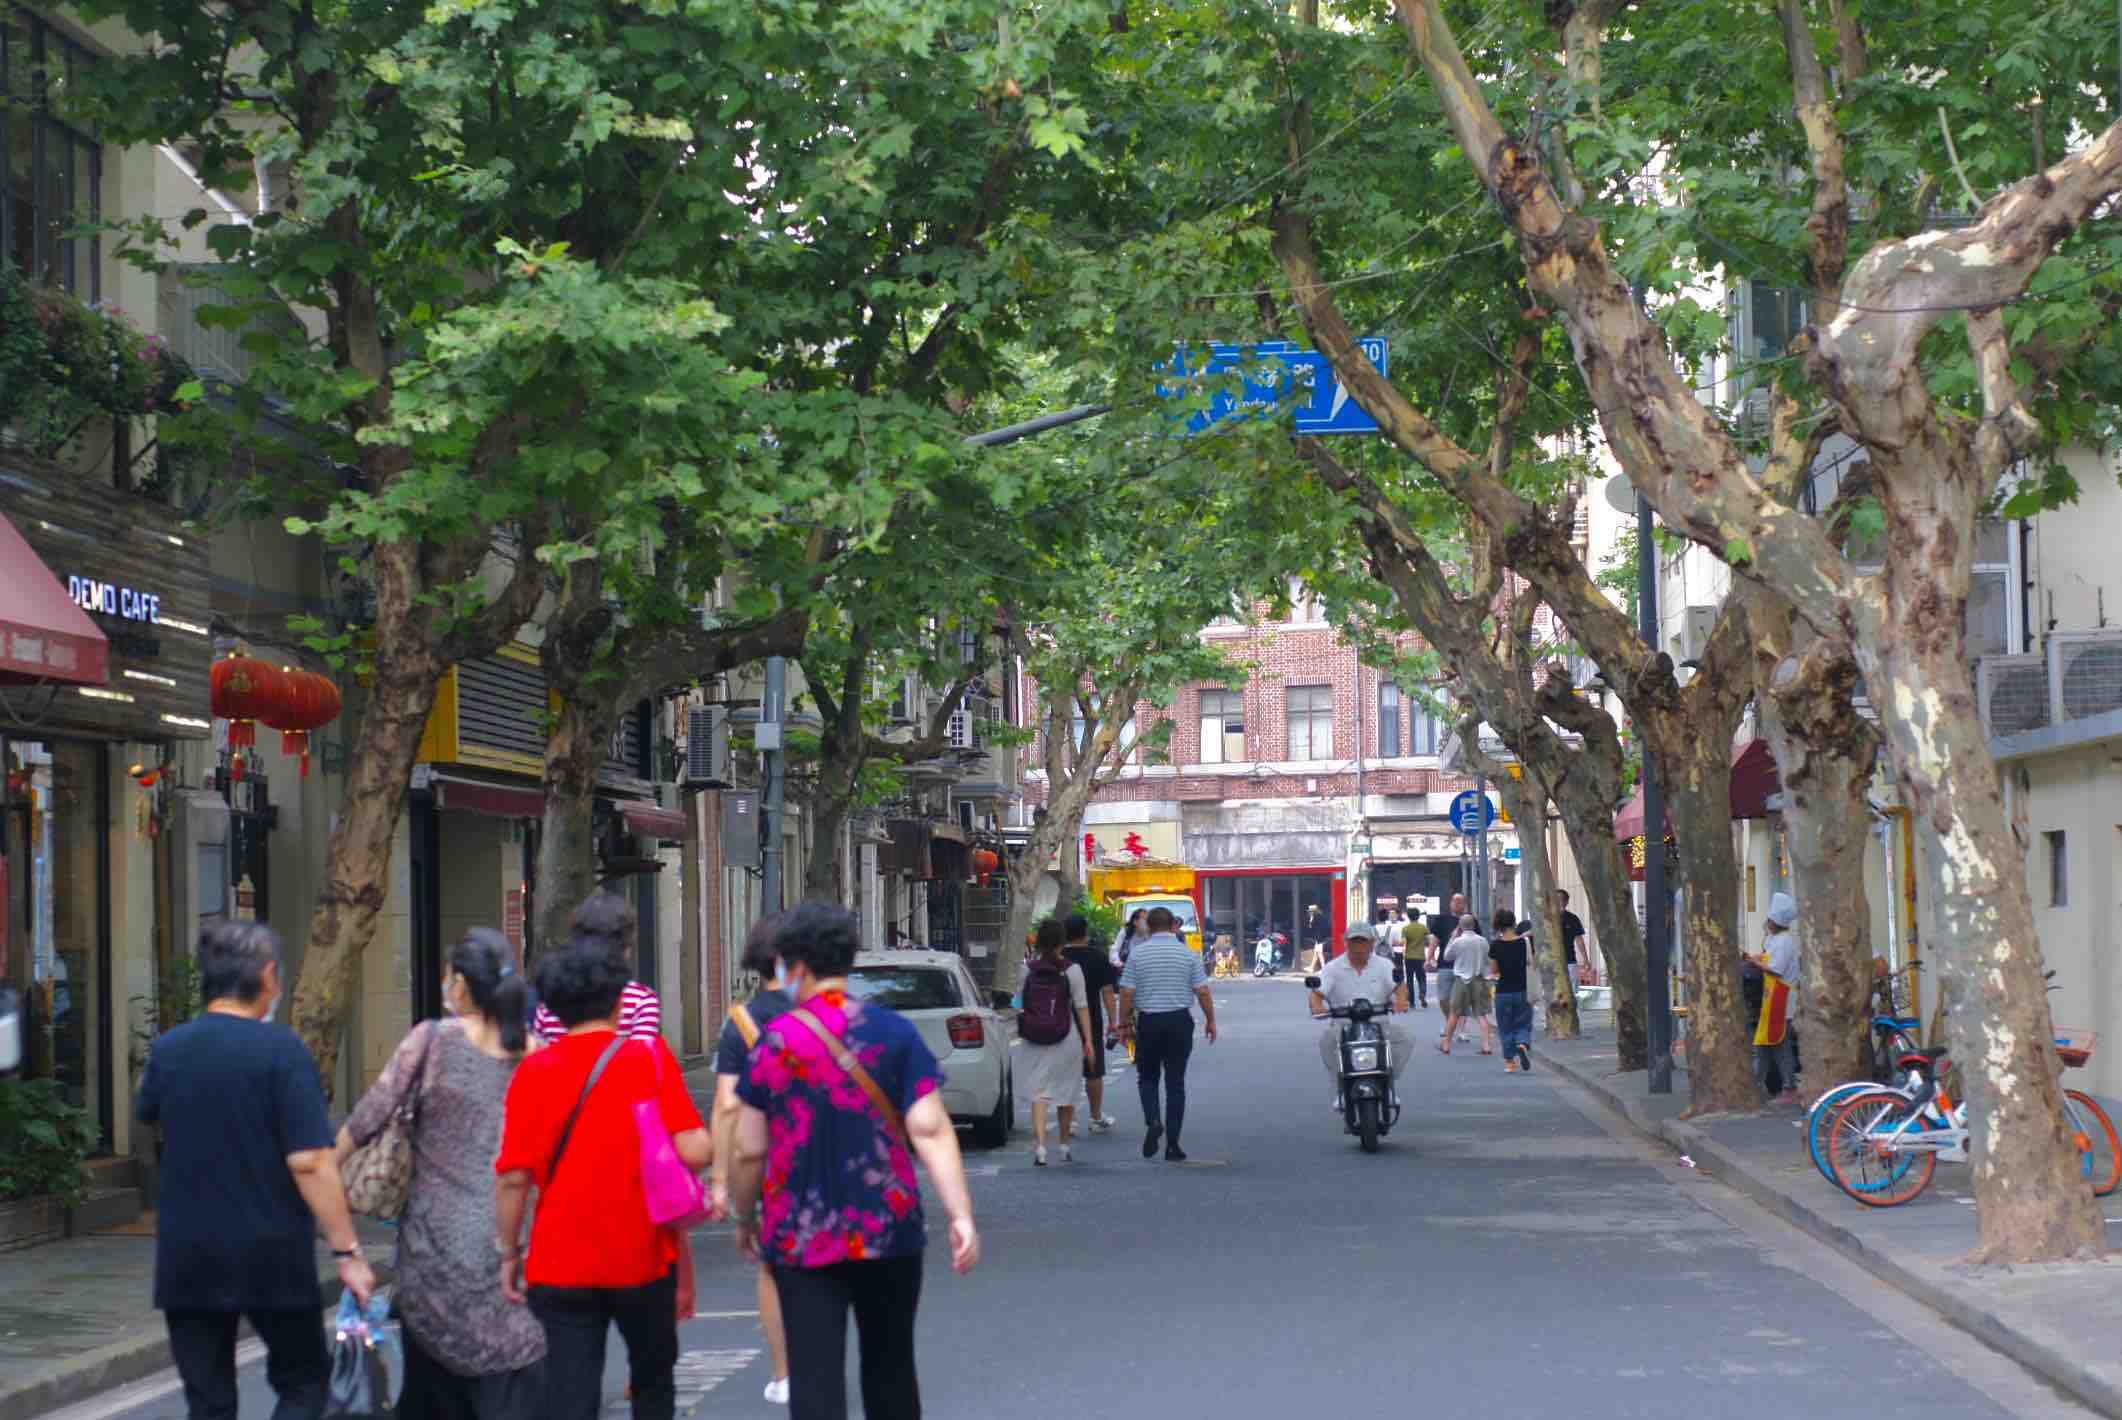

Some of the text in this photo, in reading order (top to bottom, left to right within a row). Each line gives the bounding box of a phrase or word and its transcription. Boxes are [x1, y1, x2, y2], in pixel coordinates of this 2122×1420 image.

[68, 575, 160, 625] DEMO CAFE
[1399, 836, 1474, 851] 永业大
